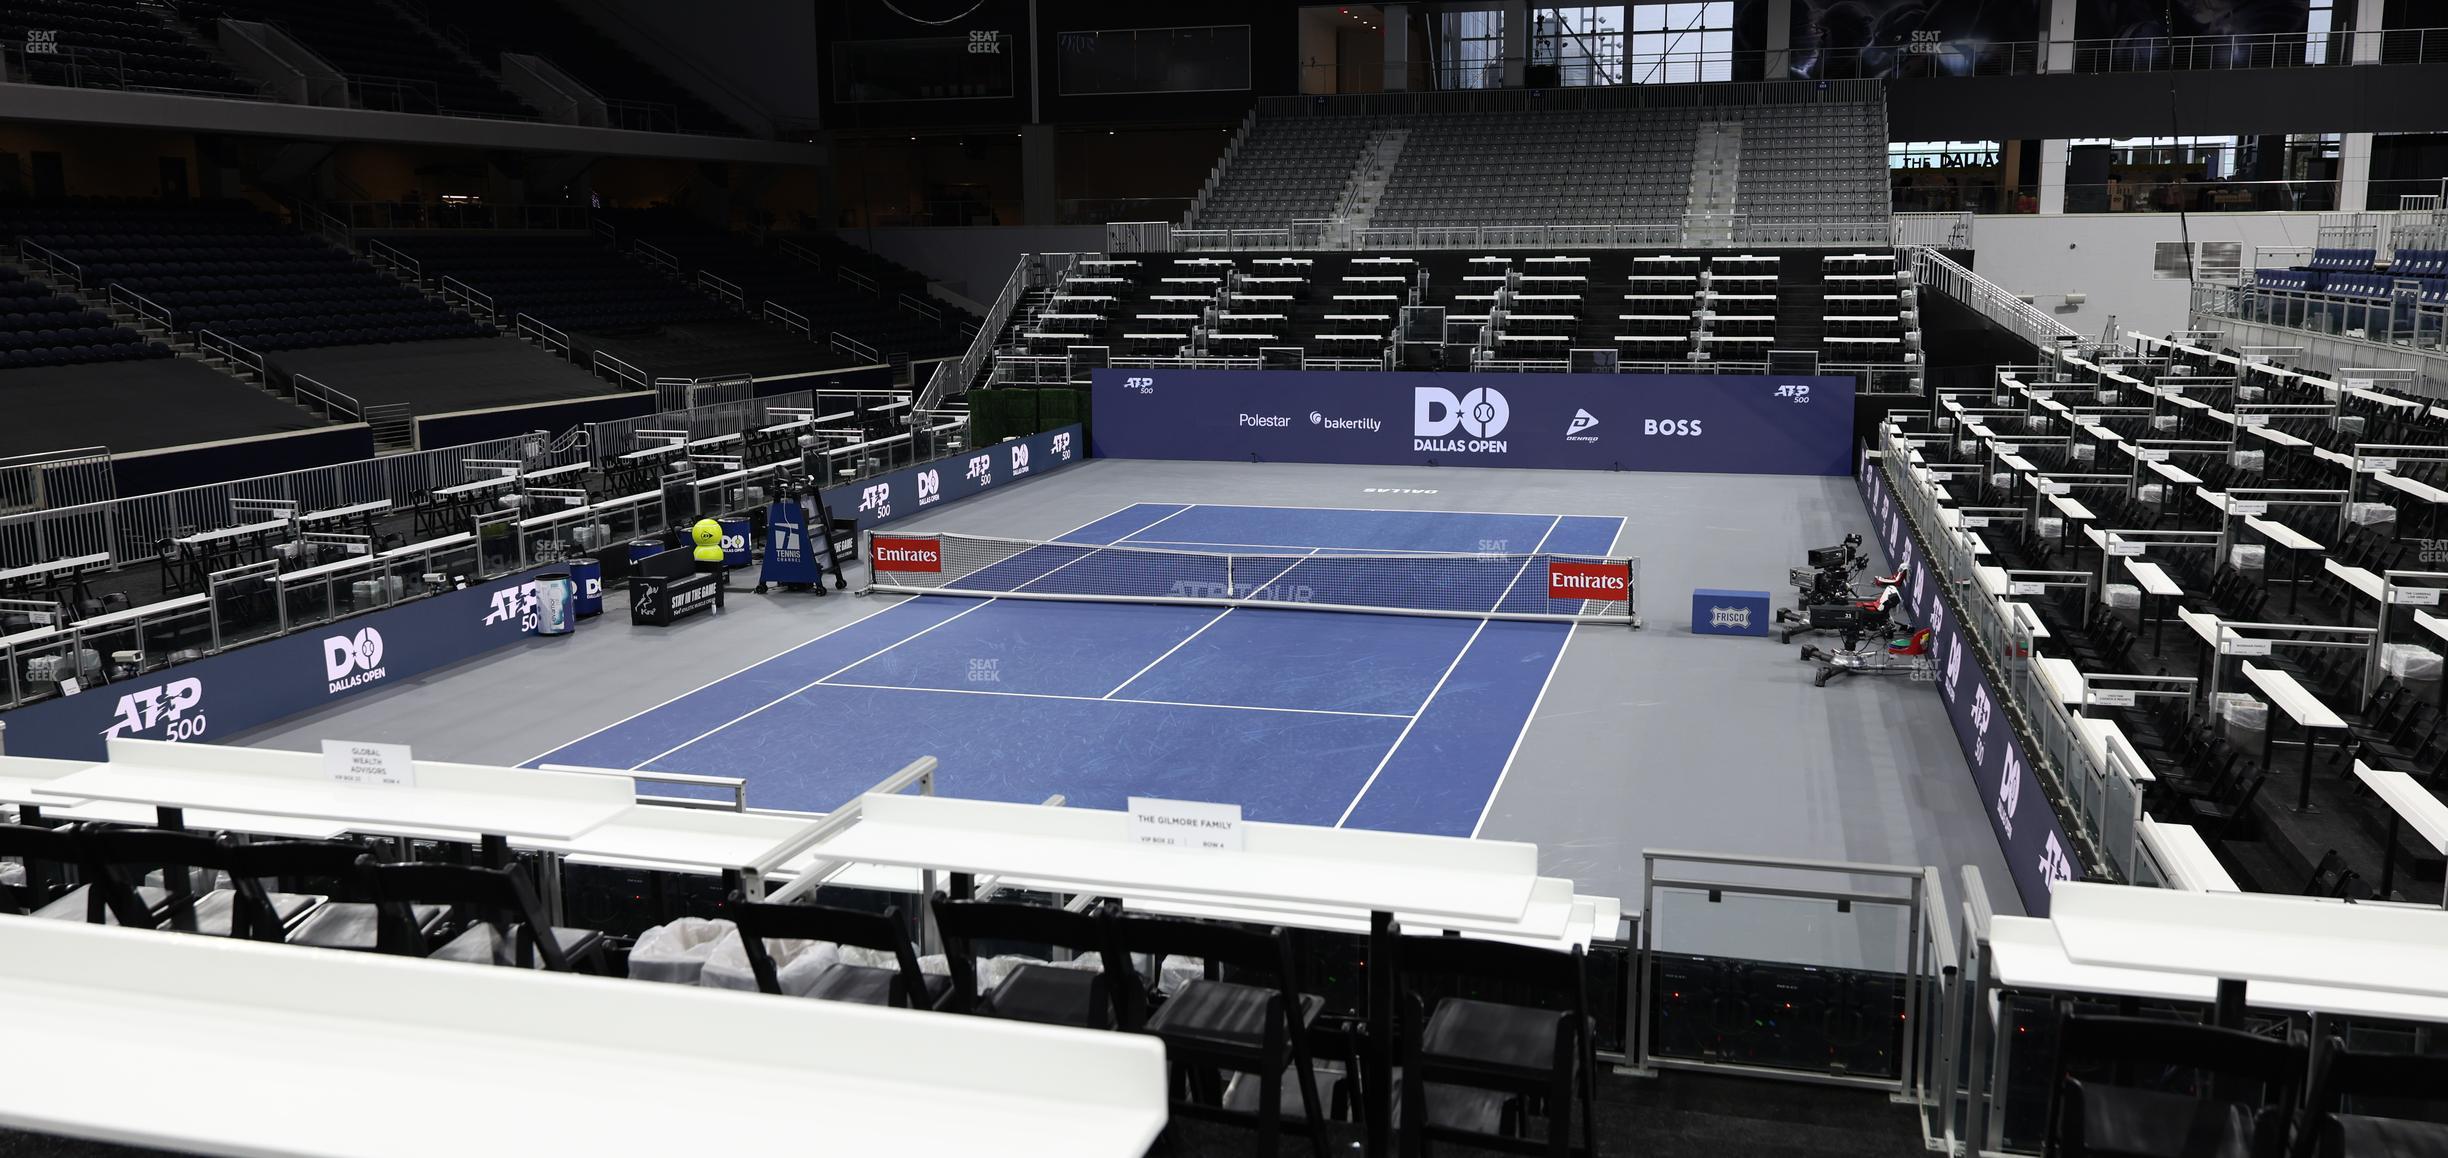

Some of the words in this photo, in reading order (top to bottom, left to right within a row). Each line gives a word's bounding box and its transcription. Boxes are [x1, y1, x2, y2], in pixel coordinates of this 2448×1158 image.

[1903, 158, 1931, 167] THE
[1124, 377, 1153, 388] ATP
[1773, 385, 1810, 397] ATP
[1794, 396, 1810, 404] 500
[1239, 413, 1291, 428] Polestar
[1324, 416, 1381, 432] bakertilly
[1644, 418, 1703, 436] BOSS
[1414, 438, 1466, 452] DALLAS
[1468, 440, 1508, 453] OPEN
[965, 454, 990, 480] ATP
[980, 472, 992, 487] 500
[858, 482, 890, 512] ATP
[877, 504, 891, 519] 500
[776, 549, 801, 558] TENNIS
[877, 546, 938, 563] Emirates
[1552, 572, 1624, 590] Emirates
[672, 593, 685, 609] STAY
[691, 587, 702, 602] THE
[701, 582, 717, 599] GAME
[521, 612, 538, 632] 50
[1715, 612, 1745, 622] FRISCO
[329, 673, 362, 694] DALLAS
[362, 667, 386, 684] OPEN
[98, 677, 202, 741] ATP
[165, 714, 207, 743] 500
[351, 747, 381, 757] GLOBAL
[353, 757, 383, 766] WEALTH
[351, 766, 388, 775] ADVISORS
[1137, 814, 1156, 825] THE
[1157, 815, 1198, 828] GILMORE
[1199, 819, 1233, 830] FAMILY
